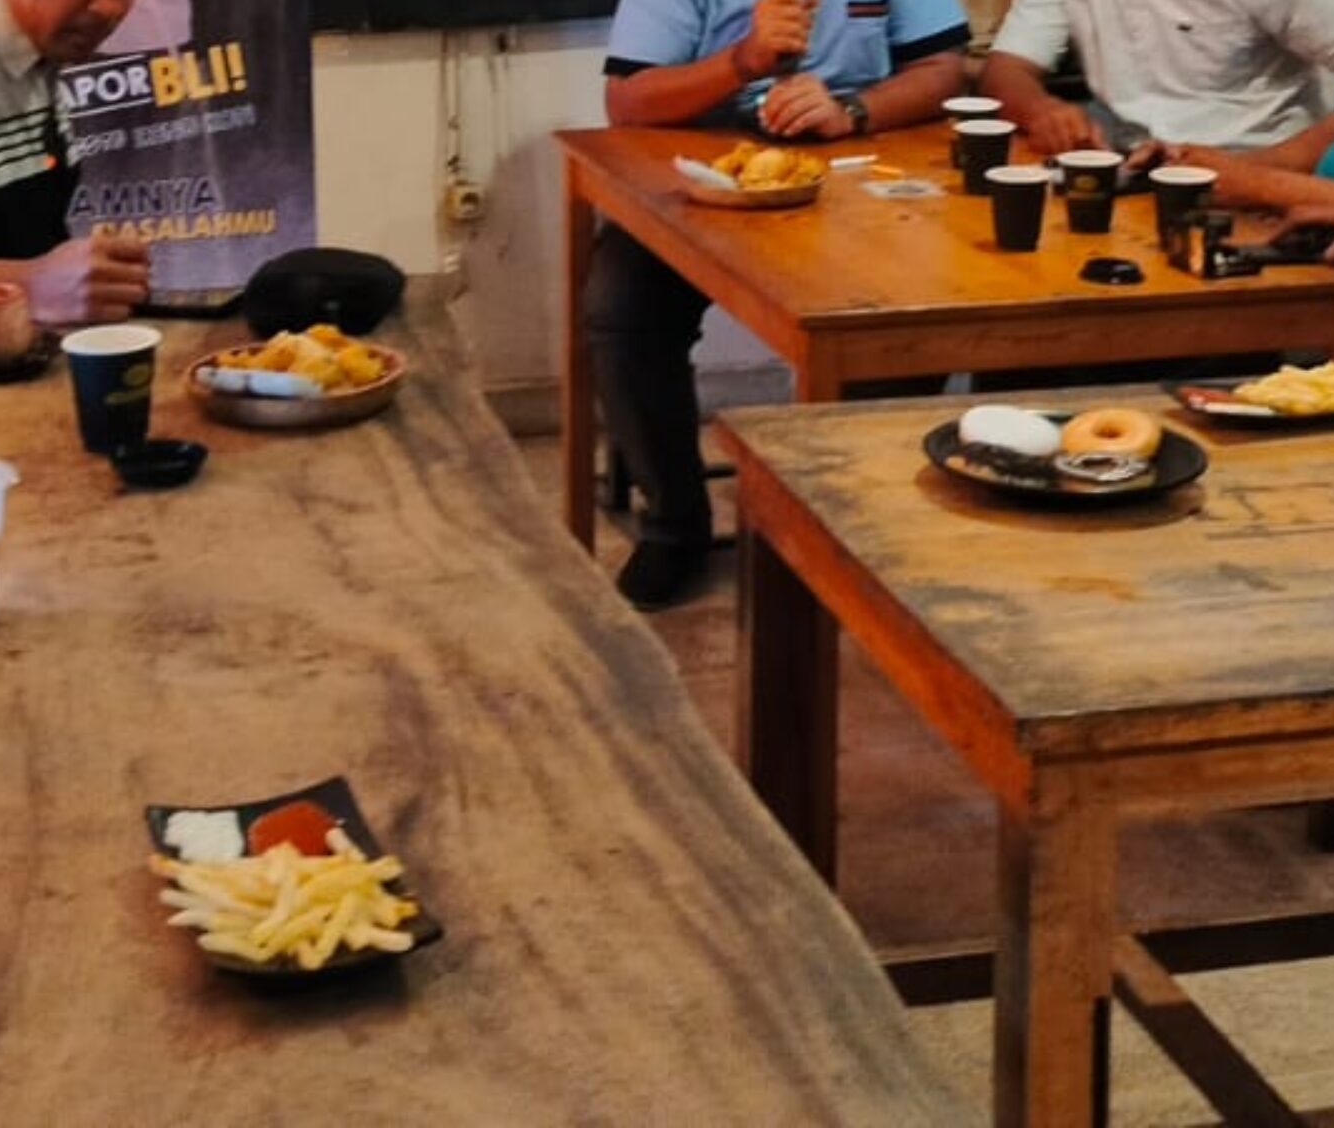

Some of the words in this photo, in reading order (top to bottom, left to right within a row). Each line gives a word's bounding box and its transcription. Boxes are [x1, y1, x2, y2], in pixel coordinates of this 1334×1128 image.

[57, 66, 151, 110] APOR
[149, 42, 247, 108] BLI!
[68, 176, 225, 219] AMNYA
